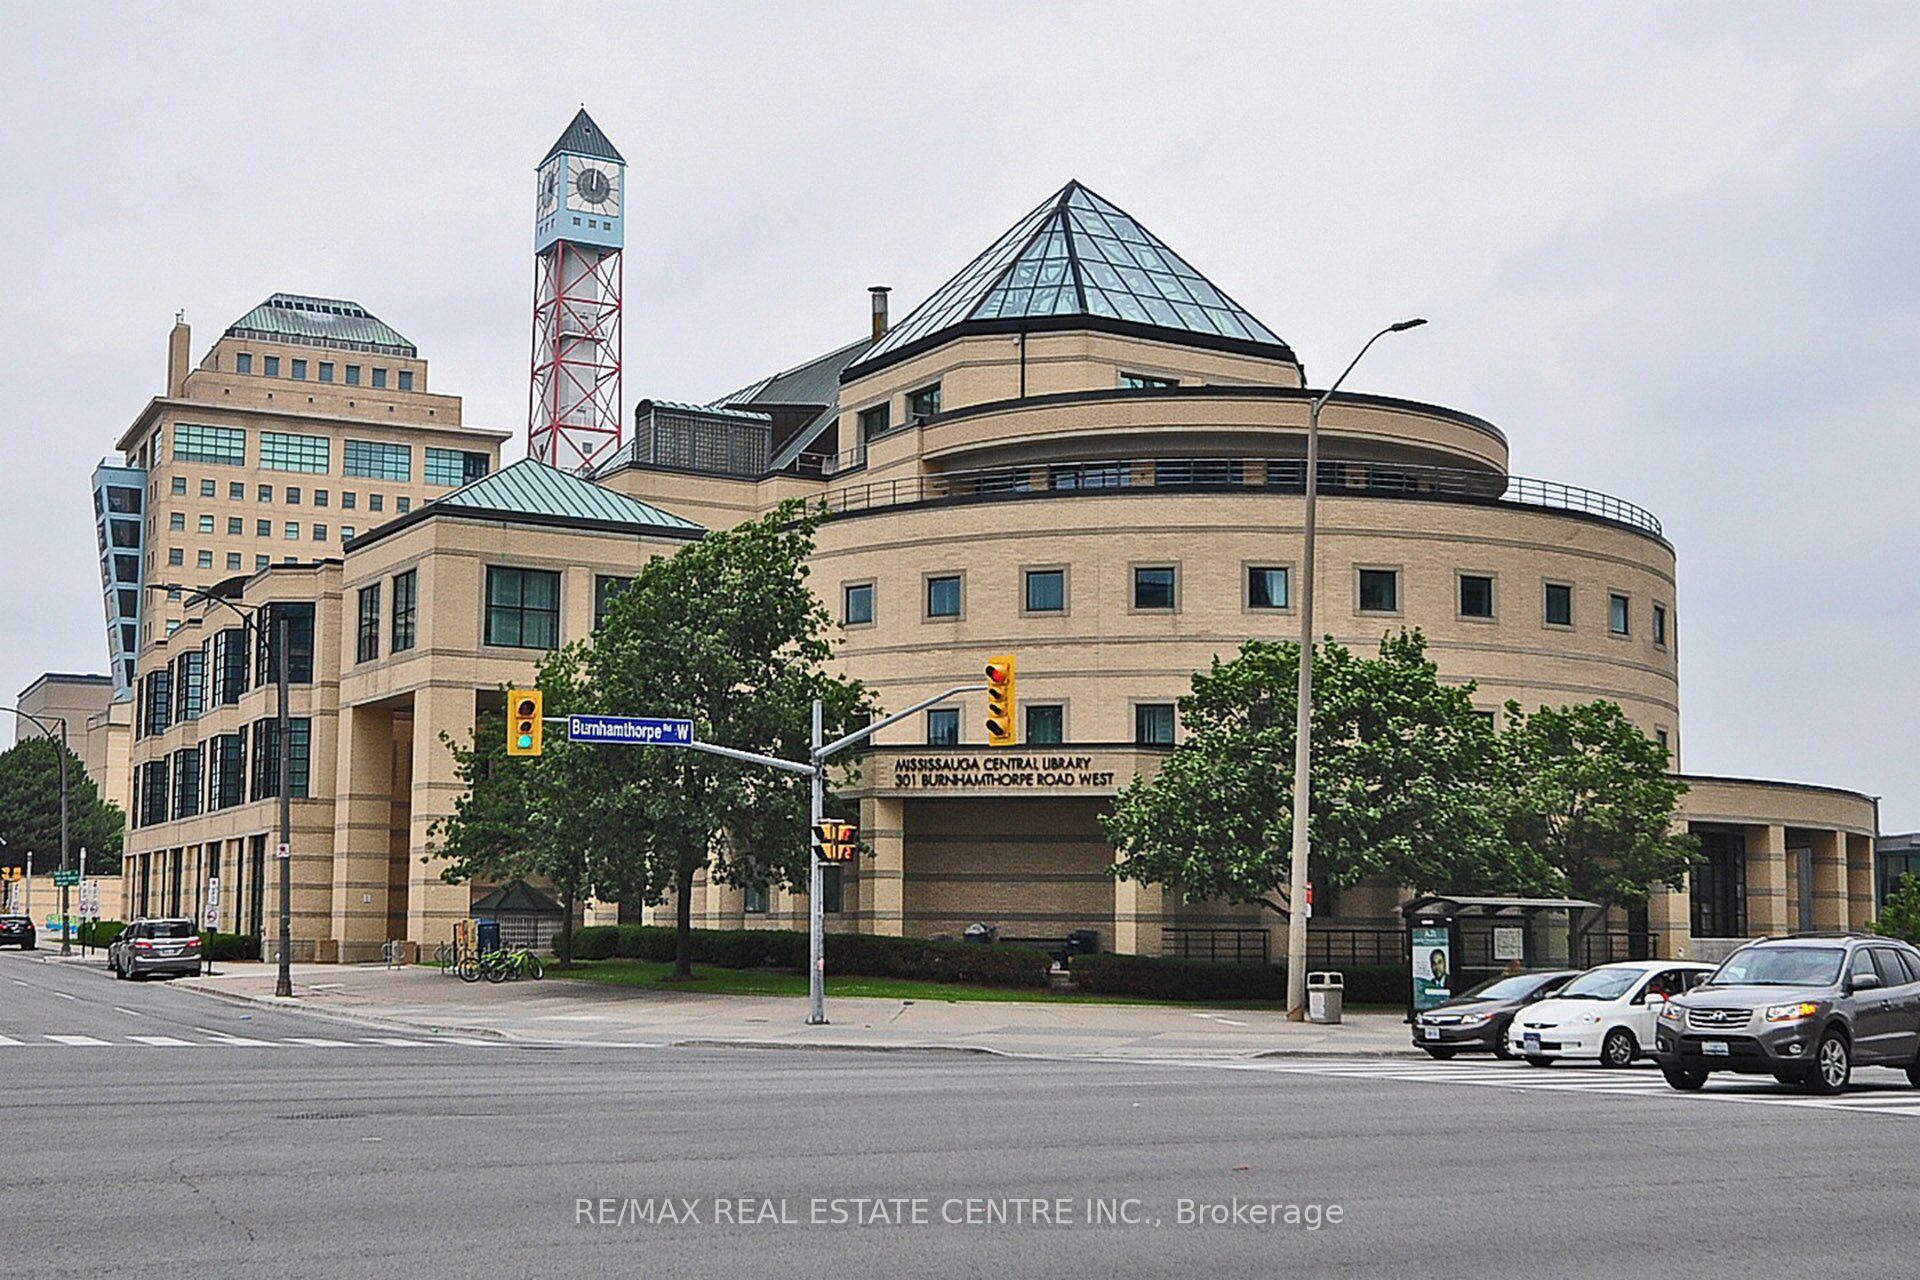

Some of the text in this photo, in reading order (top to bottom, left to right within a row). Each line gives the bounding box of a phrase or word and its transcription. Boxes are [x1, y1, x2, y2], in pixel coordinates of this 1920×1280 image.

[572, 719, 662, 743] Burnhamthorpe
[677, 724, 689, 740] W
[895, 757, 1092, 772] MISSISSAUGA CENTRAL LIBRARY
[895, 772, 1115, 787] 301 BURNHAMTHORPE ROAD WEST
